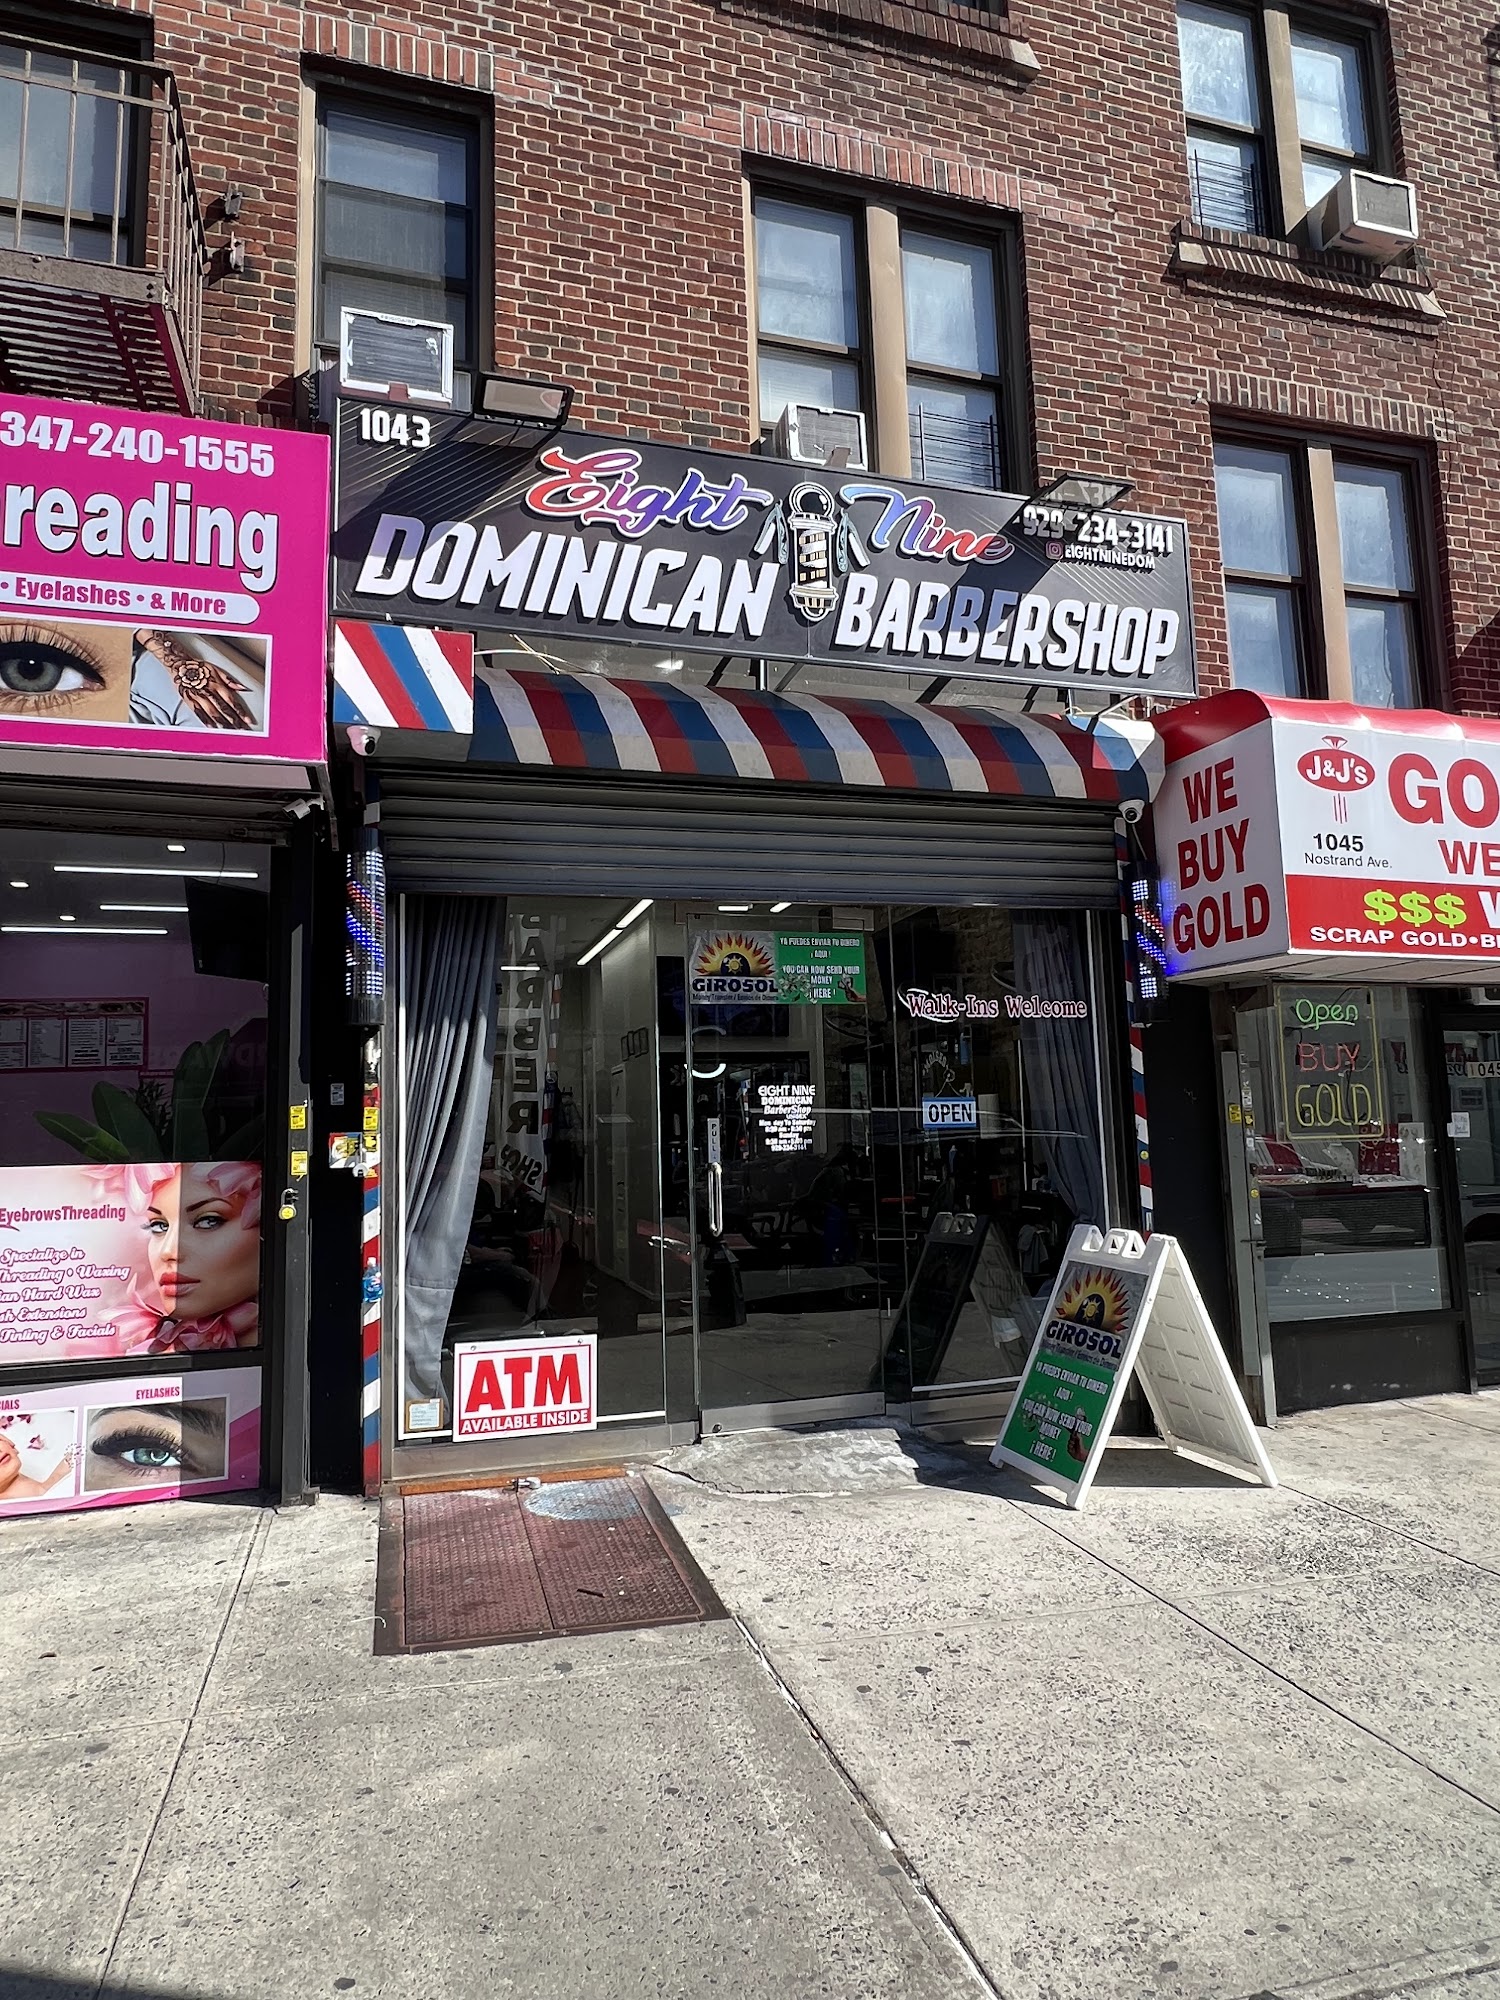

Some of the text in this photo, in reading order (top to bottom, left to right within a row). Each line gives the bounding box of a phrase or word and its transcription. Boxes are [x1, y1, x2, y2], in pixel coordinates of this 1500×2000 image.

[360, 407, 431, 448] 1043
[0, 410, 275, 478] 347-240-1555
[526, 446, 1015, 564] Eight Nine
[3, 481, 279, 593] reading
[1065, 543, 1156, 569] EIGHTNINEDOM
[15, 576, 227, 616] Eyelashes & More
[355, 512, 1180, 675] DOMINICAN BARBERSHOP
[1305, 755, 1369, 785] J&J's
[1182, 757, 1238, 824] WE
[1177, 818, 1250, 891] BUY
[1312, 833, 1364, 853] 1045
[1304, 853, 1394, 870] Nostrand Ave.
[1172, 883, 1271, 954] GOLD
[1310, 926, 1396, 945] SCRAP
[692, 978, 779, 993] GIROSOL
[906, 993, 1088, 1019] Walk-Ins Welcome
[1295, 999, 1359, 1030] Open
[1297, 1043, 1360, 1072] BUY
[758, 1084, 816, 1096] EIGHT NINE
[761, 1096, 813, 1105] DOMINICAN
[928, 1103, 972, 1123] OPEN
[1295, 1083, 1372, 1127] GOLD
[0, 1246, 86, 1267] Specialize in
[76, 1264, 131, 1281] Waxing
[22, 1286, 64, 1302] Hard
[65, 1284, 102, 1300] Wax
[17, 1305, 87, 1322] Extensions
[0, 1322, 116, 1345] Tinting & Facials
[1046, 1320, 1122, 1359] GIROSOL
[136, 1386, 181, 1400] EYELASHES
[464, 1353, 583, 1414] ATM
[460, 1414, 538, 1434] AVAILABLE
[541, 1409, 589, 1427] INSIDE
